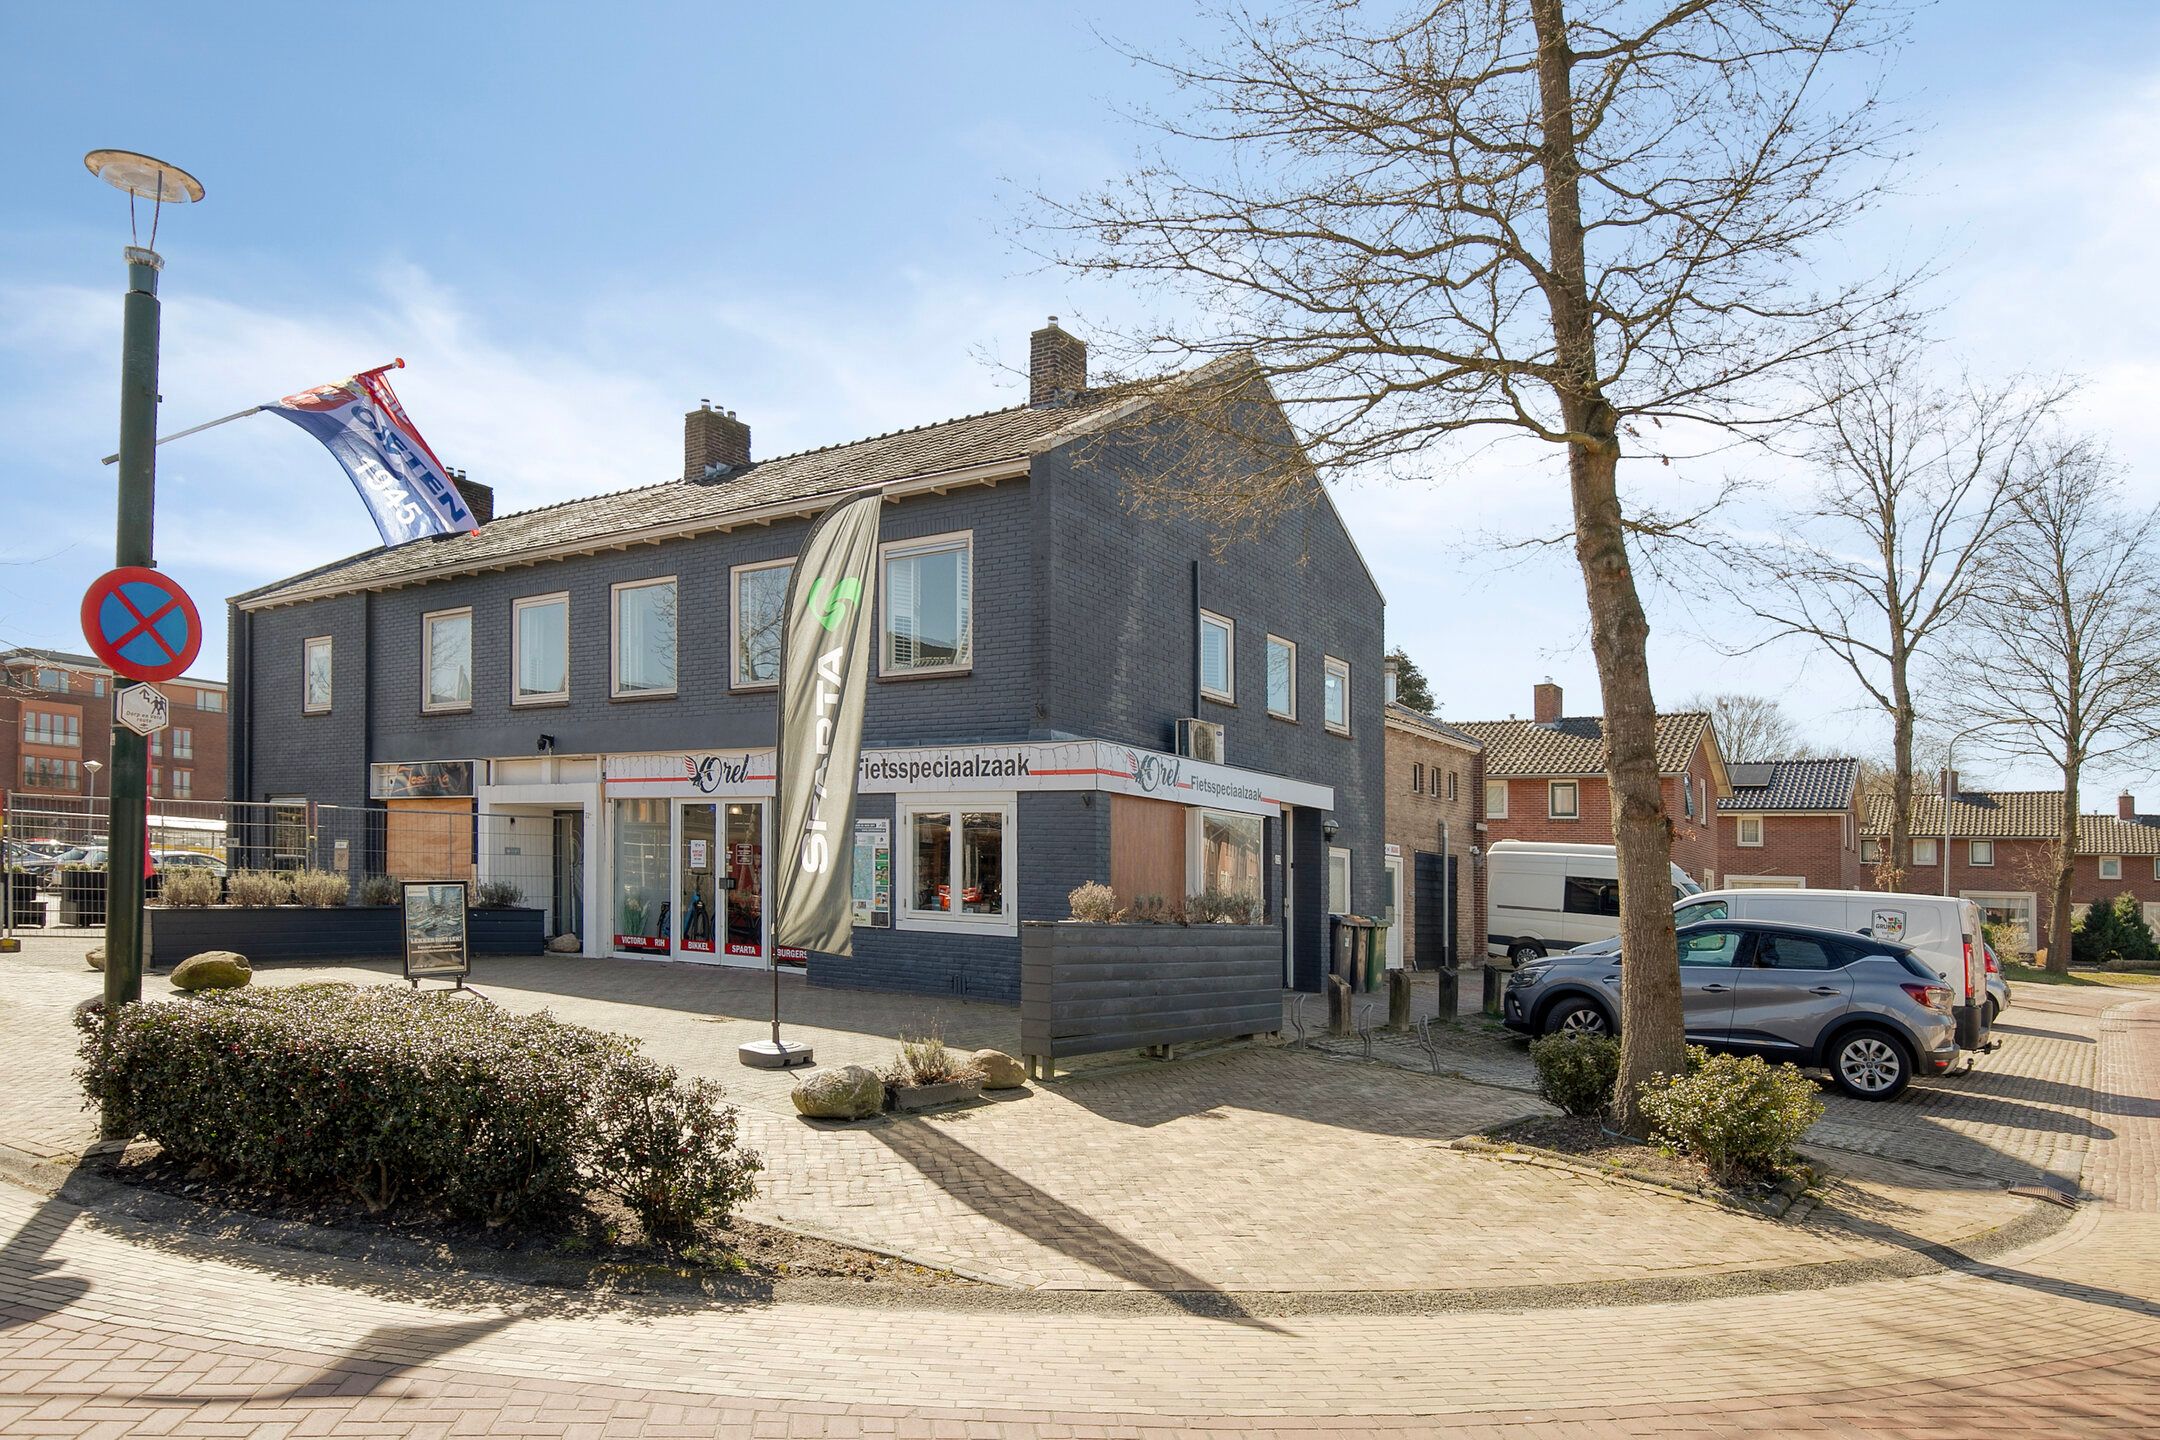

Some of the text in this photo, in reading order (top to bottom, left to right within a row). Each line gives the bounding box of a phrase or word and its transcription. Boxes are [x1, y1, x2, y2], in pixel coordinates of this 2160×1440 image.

[355, 456, 423, 525] 1945
[1190, 775, 1264, 802] Fietsspeciaalzaak
[621, 935, 647, 946] VICTORIA
[654, 938, 665, 947] RIH
[687, 941, 710, 951] BIKKEL
[731, 944, 756, 955] SPARTA
